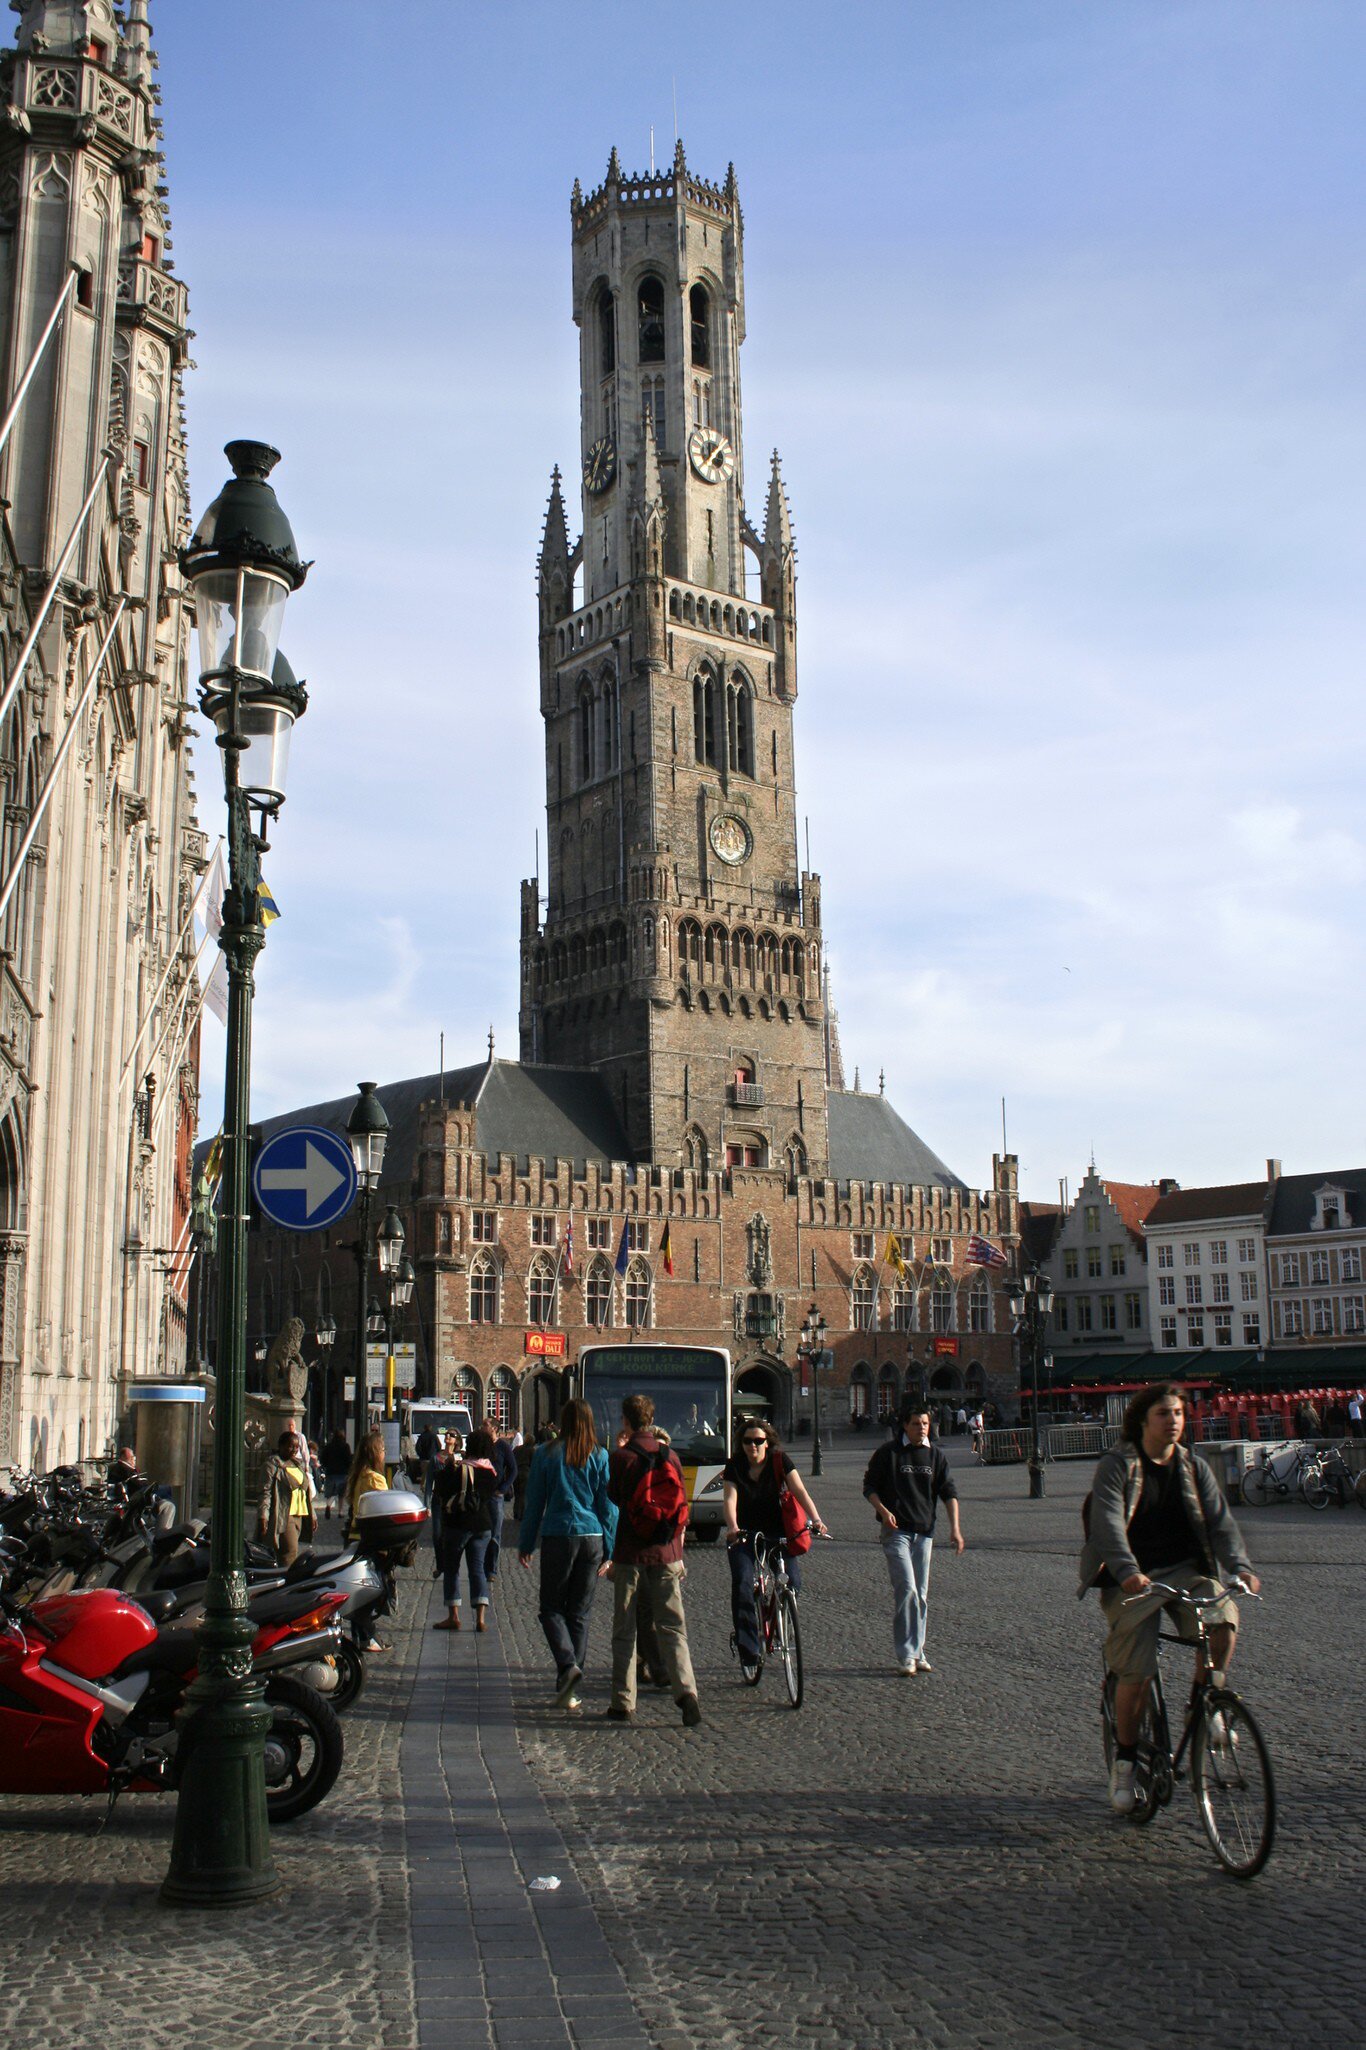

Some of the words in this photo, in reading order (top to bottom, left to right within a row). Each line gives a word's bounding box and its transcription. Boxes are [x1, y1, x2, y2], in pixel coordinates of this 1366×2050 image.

[545, 1344, 561, 1354] DALI
[594, 1353, 604, 1371] 4
[606, 1353, 655, 1362] CENTRUM
[623, 1362, 696, 1373] KOOLKERKE
